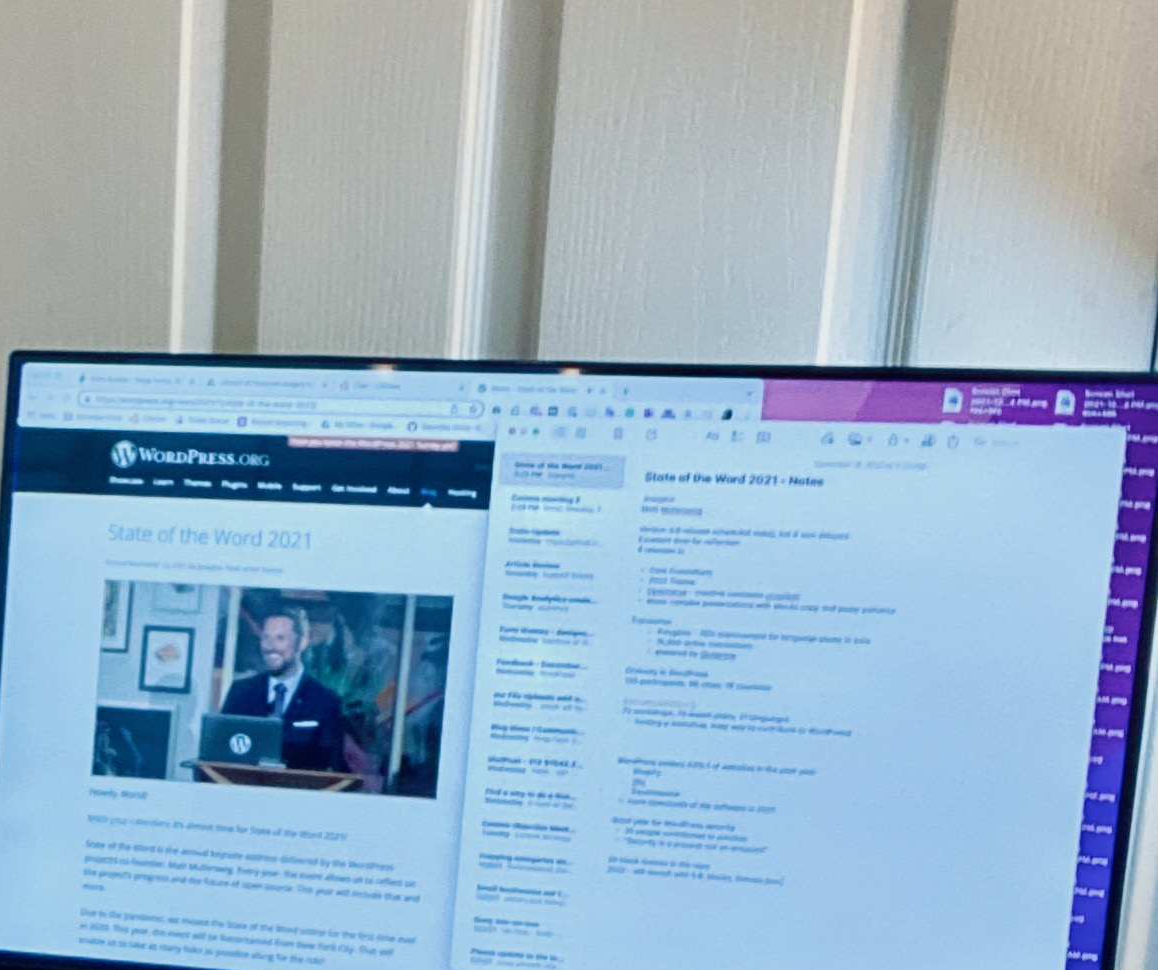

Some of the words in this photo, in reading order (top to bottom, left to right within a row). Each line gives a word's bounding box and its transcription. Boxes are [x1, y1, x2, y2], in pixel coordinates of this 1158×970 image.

[644, 471, 676, 484] State
[678, 472, 691, 484] of
[694, 472, 712, 484] the
[715, 473, 746, 485] Word
[749, 474, 778, 486] 2021
[789, 475, 824, 487] Notes
[108, 523, 152, 542] State
[157, 524, 178, 543] of
[180, 526, 210, 545] the
[214, 528, 262, 547] Word
[268, 530, 312, 550] 2021
